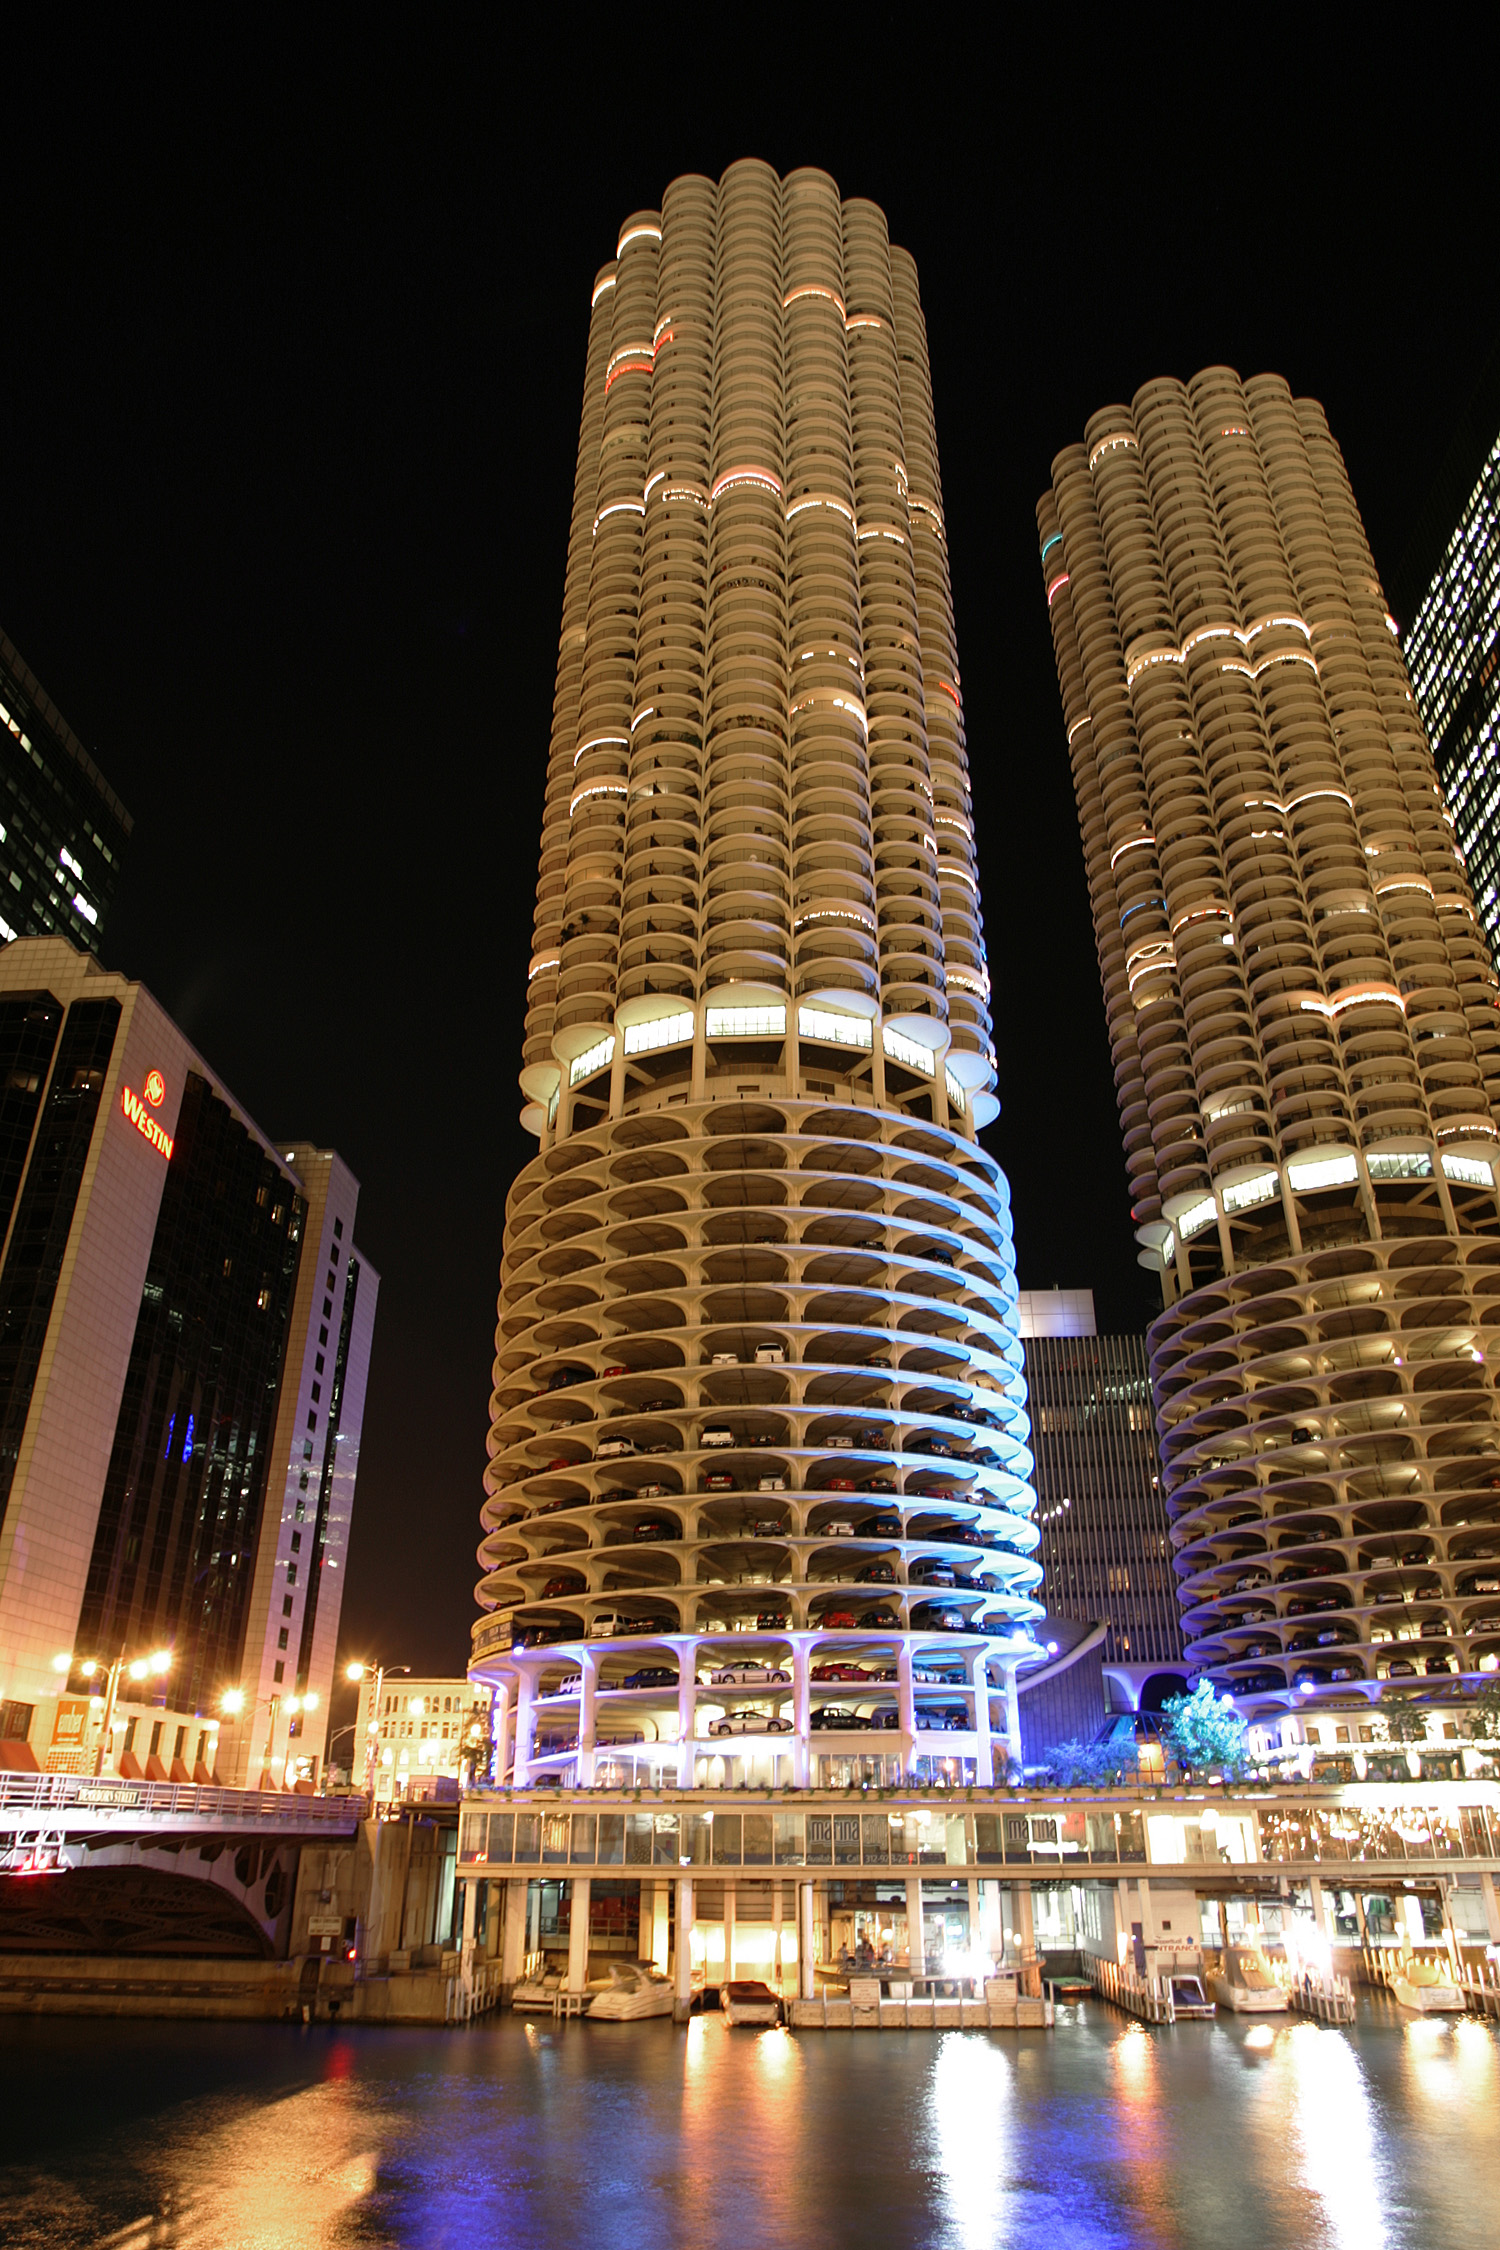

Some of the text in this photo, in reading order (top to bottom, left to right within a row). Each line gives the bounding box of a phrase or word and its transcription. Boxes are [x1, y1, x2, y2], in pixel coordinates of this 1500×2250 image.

[123, 1086, 173, 1160] WESTIN
[811, 1820, 860, 1841] marina
[1154, 1944, 1200, 1952] NTRANCE
